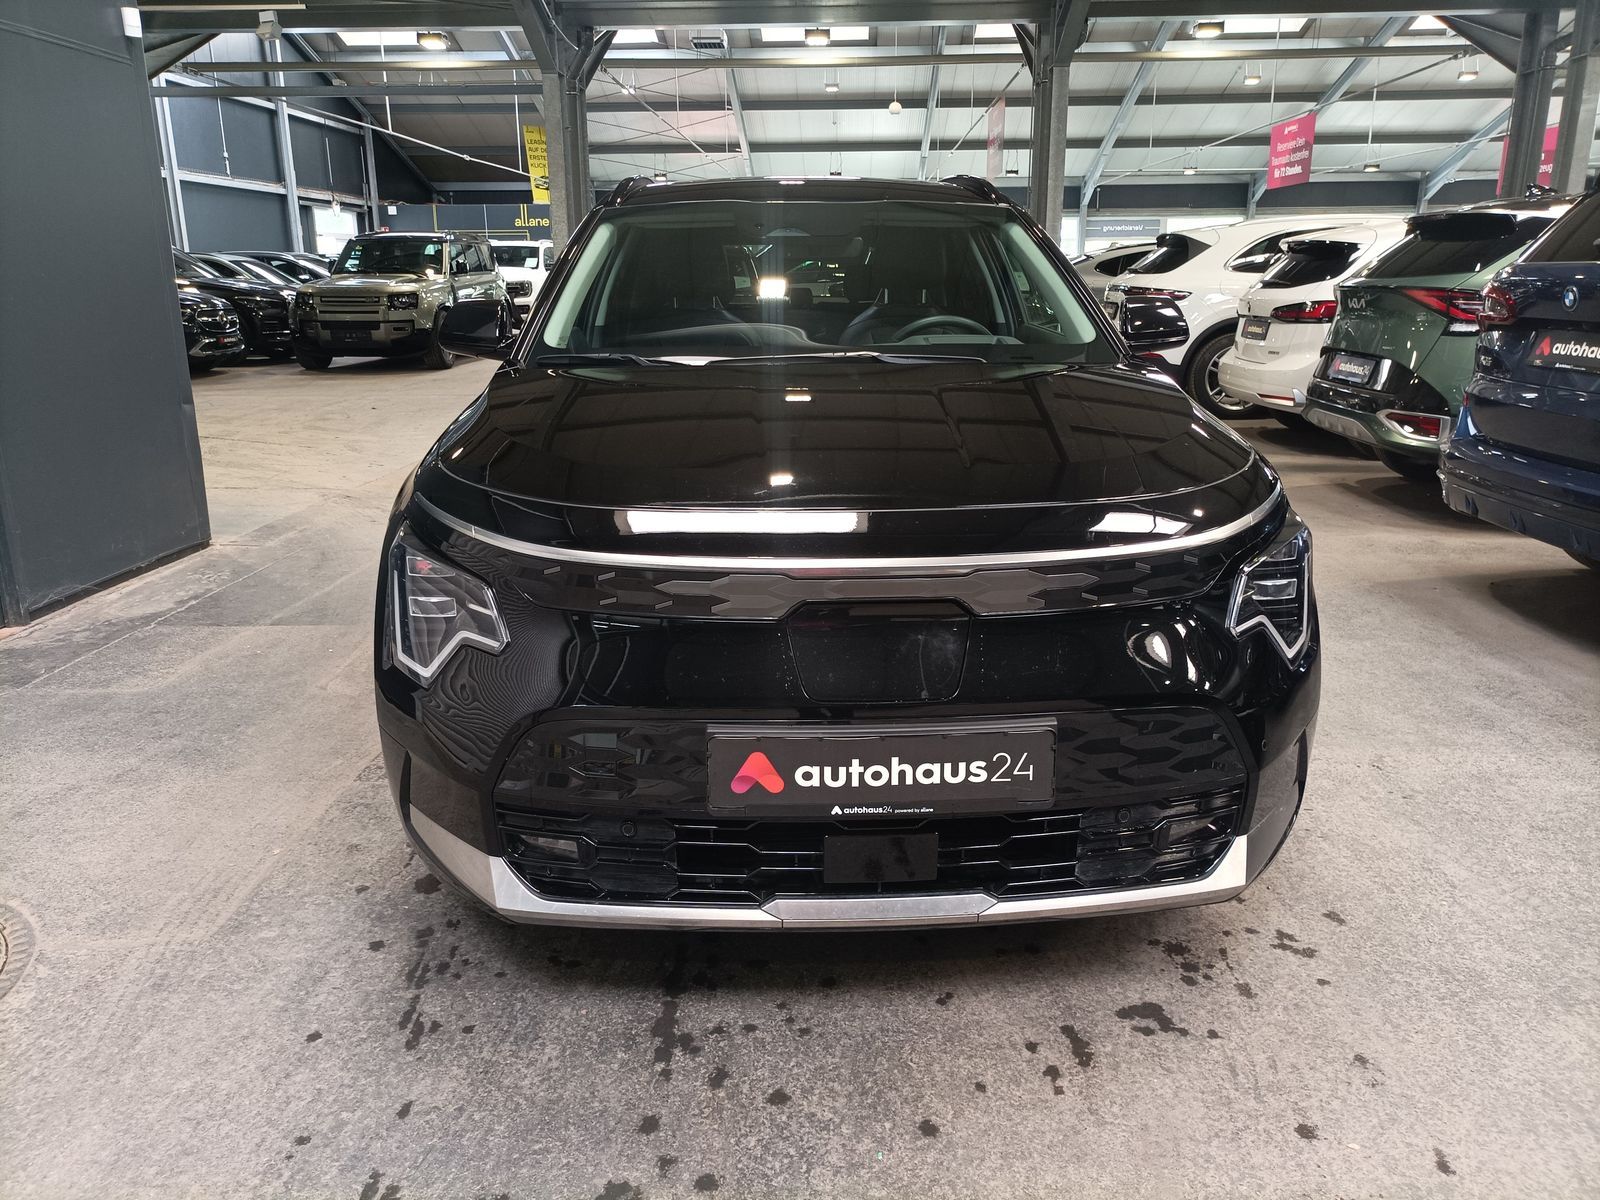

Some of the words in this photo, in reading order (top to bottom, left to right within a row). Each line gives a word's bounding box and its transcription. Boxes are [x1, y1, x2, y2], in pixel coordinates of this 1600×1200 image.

[1539, 163, 1553, 174] zeug
[794, 752, 1034, 788] autohaus24
[843, 805, 893, 814] autohaus24
